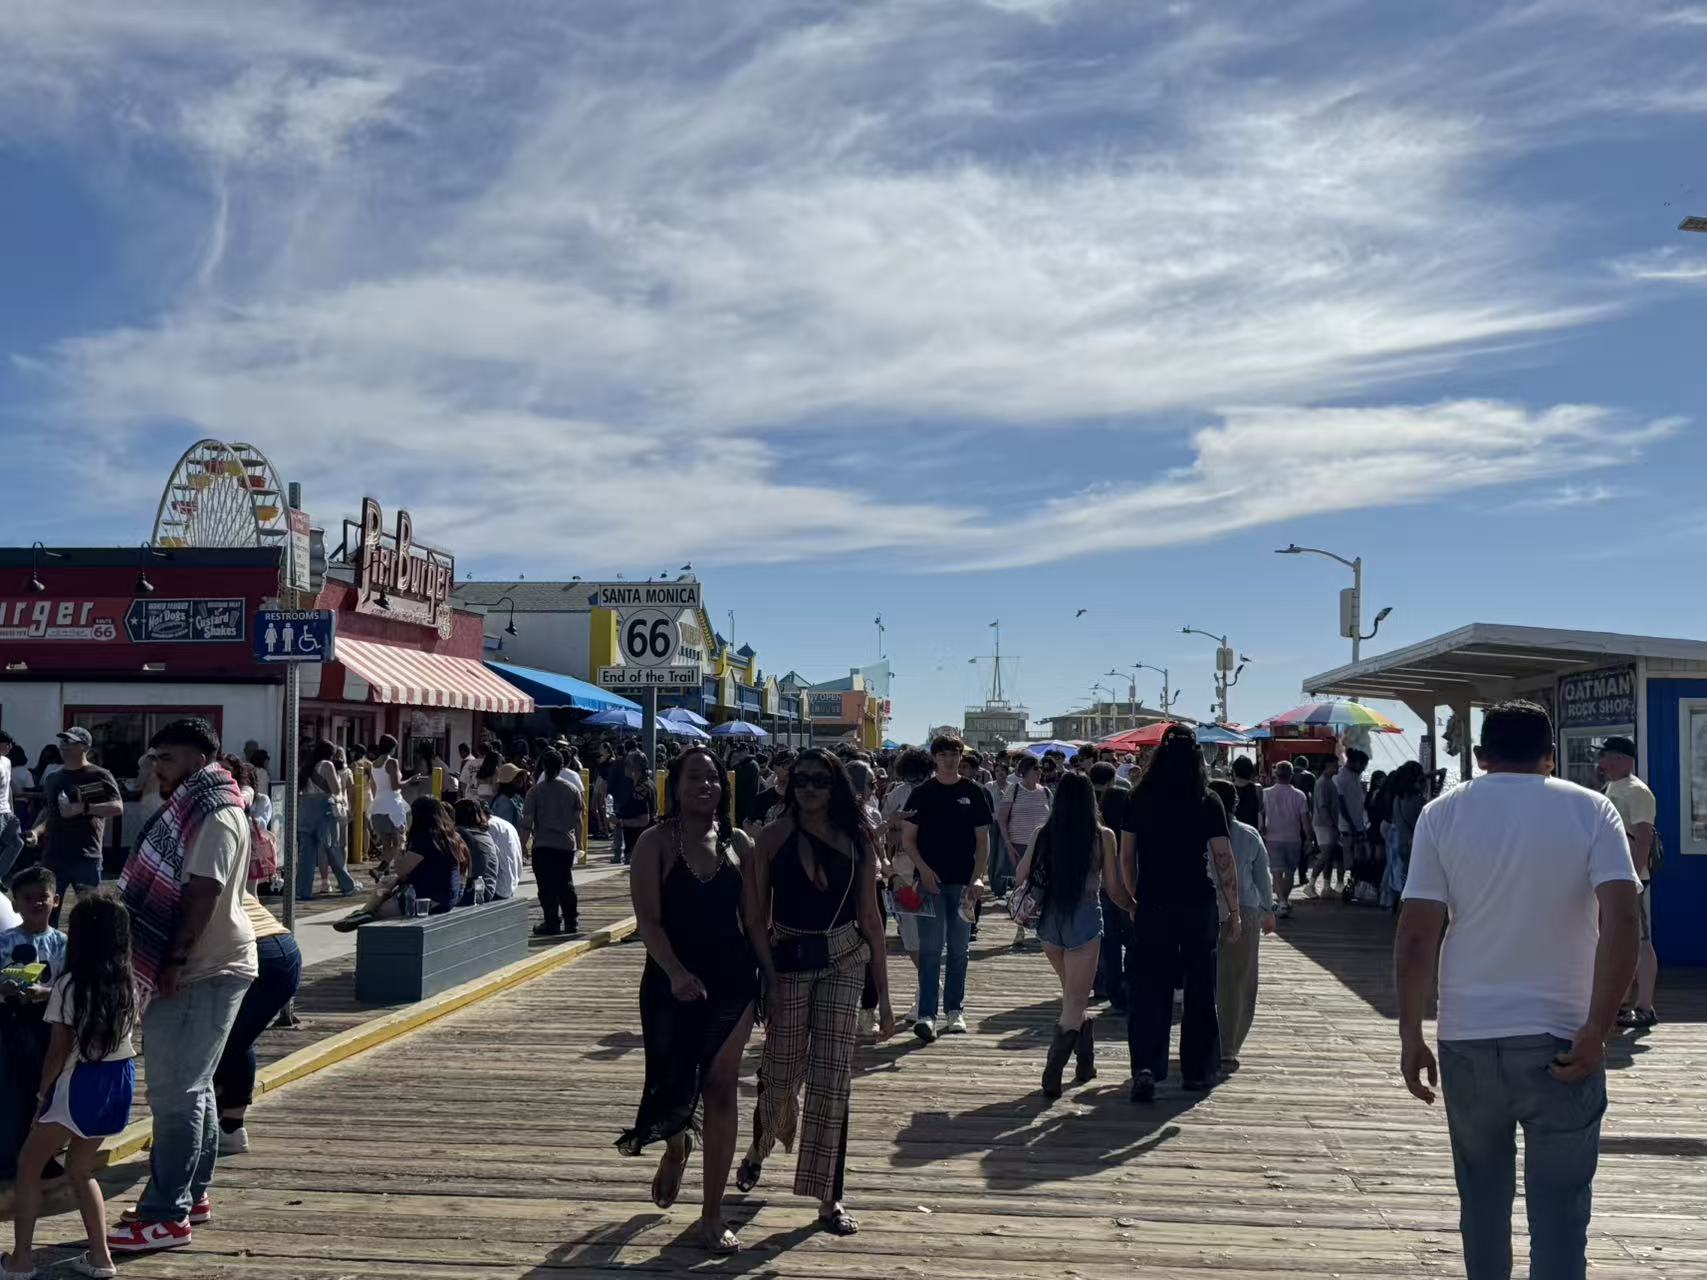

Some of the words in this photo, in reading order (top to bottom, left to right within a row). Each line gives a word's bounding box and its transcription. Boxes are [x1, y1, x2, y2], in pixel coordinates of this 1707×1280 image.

[602, 588, 641, 604] SANTA
[646, 588, 696, 604] MONICA
[163, 610, 186, 621] Dogs
[195, 611, 229, 631] Custard
[265, 612, 319, 621] RESTROOMS
[93, 626, 113, 638] 66
[204, 625, 237, 638] Shakes
[627, 618, 671, 658] 66
[602, 670, 625, 683] End
[629, 669, 642, 683] of
[646, 669, 665, 683] the
[669, 670, 695, 683] Trail
[1564, 674, 1630, 701] OATMAN
[1568, 701, 1597, 717] ROCK
[1600, 697, 1629, 714] SHOP
